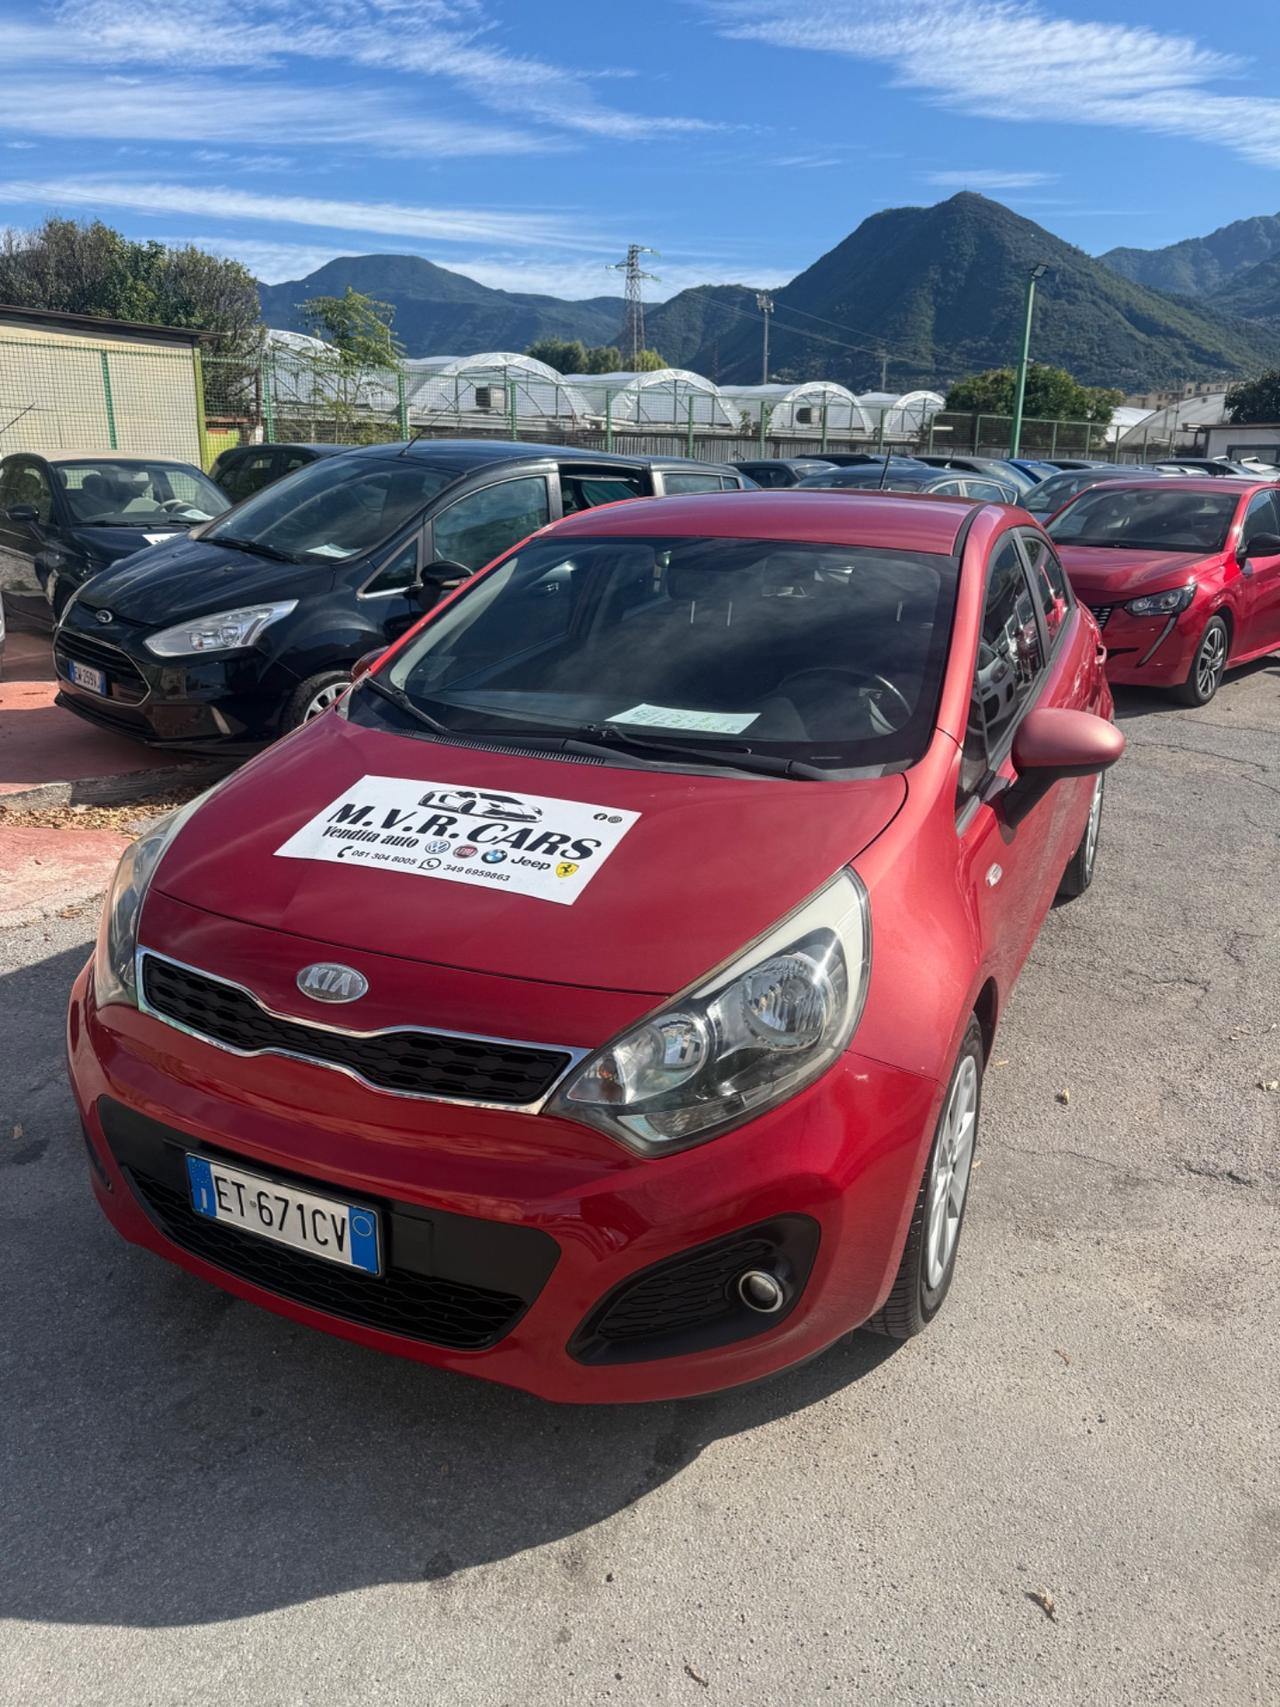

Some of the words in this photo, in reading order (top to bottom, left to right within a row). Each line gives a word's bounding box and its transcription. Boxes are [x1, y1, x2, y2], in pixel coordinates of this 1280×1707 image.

[322, 826, 380, 843] Vendita
[380, 834, 419, 848] auto
[443, 864, 463, 873] 349
[511, 856, 551, 871] Jeep
[304, 966, 353, 996] KIA
